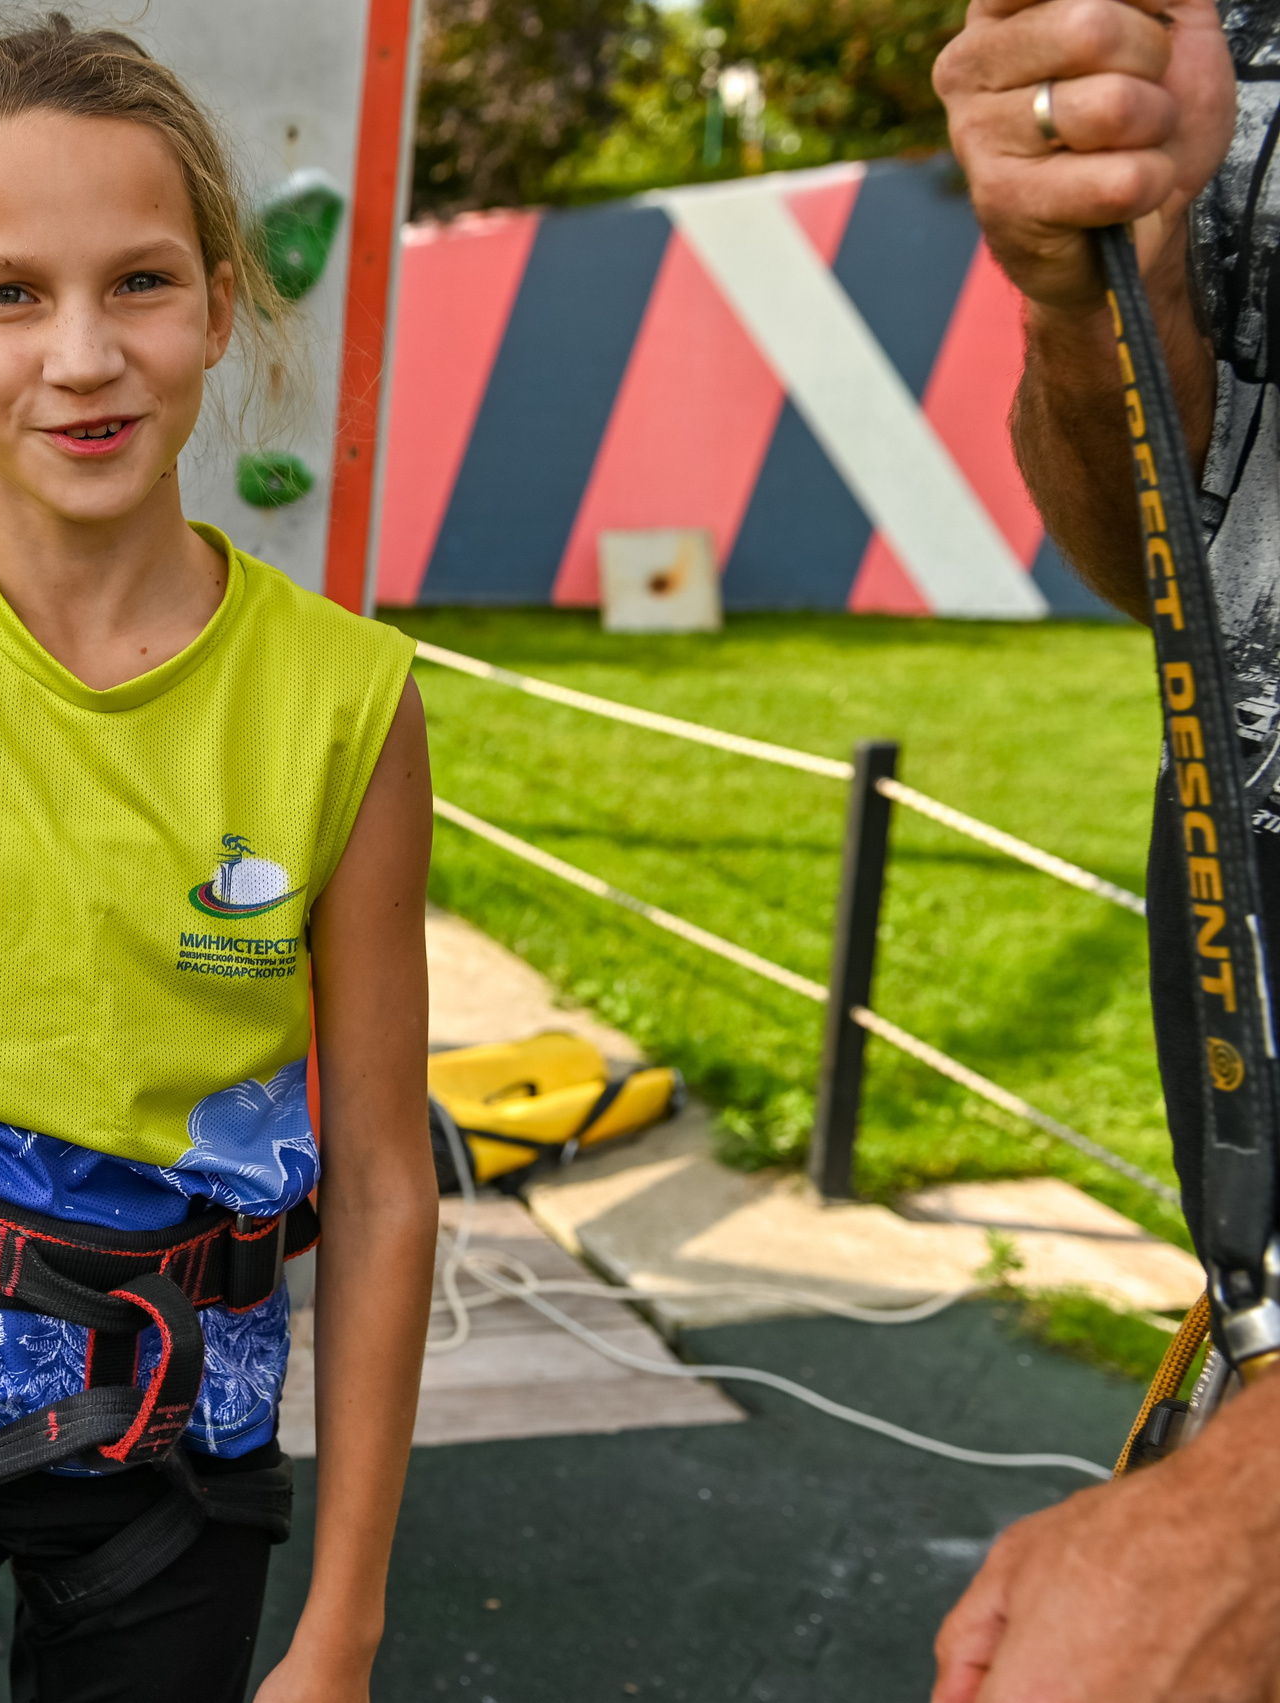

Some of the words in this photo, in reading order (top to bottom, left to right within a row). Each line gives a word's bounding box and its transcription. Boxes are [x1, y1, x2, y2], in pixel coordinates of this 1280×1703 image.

[1163, 661, 1237, 1013] DESCENT
[179, 950, 233, 963] ФИЗИЧЕСКОЙ
[234, 955, 277, 966] КУЛЬТУРЫ
[176, 961, 286, 978] КРАСНОДАРСКОГО
